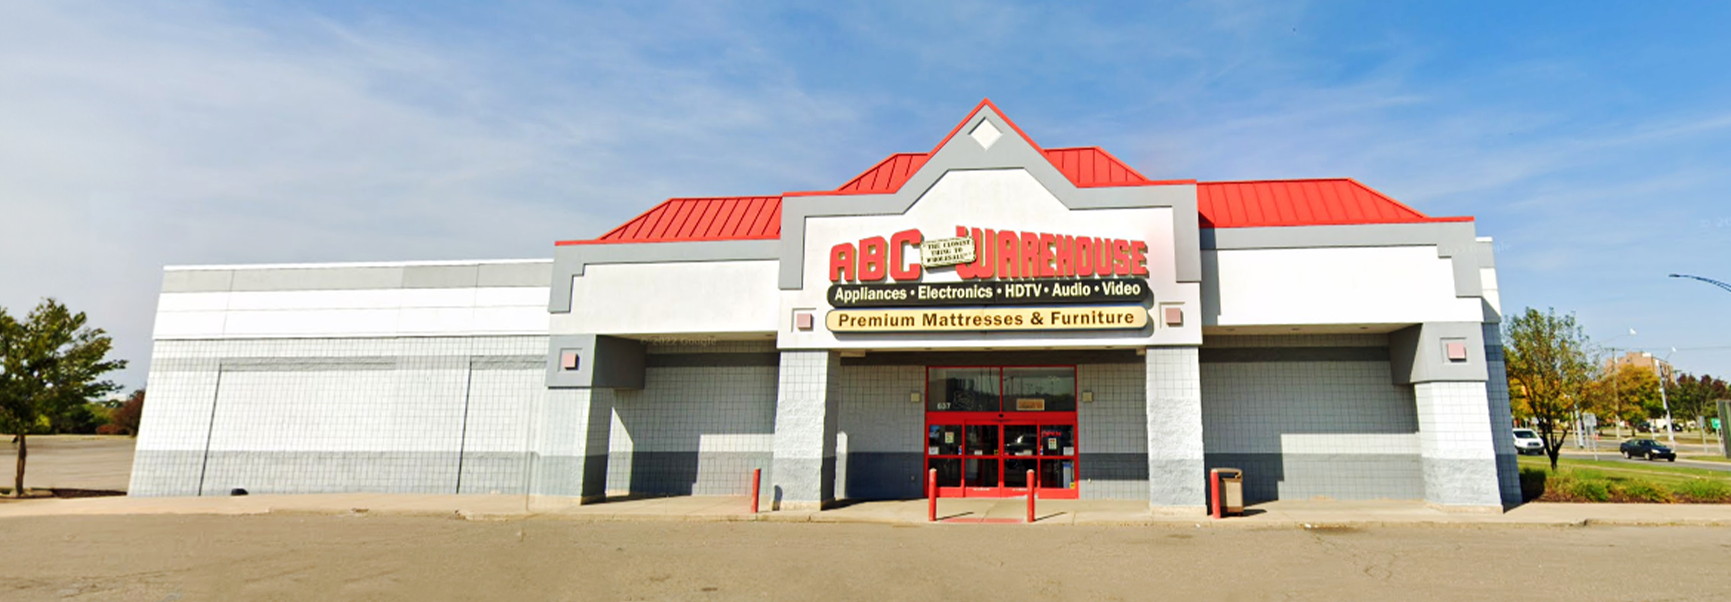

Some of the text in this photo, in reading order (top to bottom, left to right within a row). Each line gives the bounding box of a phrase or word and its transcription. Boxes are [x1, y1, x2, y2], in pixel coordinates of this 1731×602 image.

[829, 225, 1148, 282] ABC WAREHOUSE
[834, 281, 1141, 303] Appliances Electronics HDTV Audio Video
[838, 310, 1135, 327] Premium Mattresses & Furniture
[937, 401, 952, 410] 637
